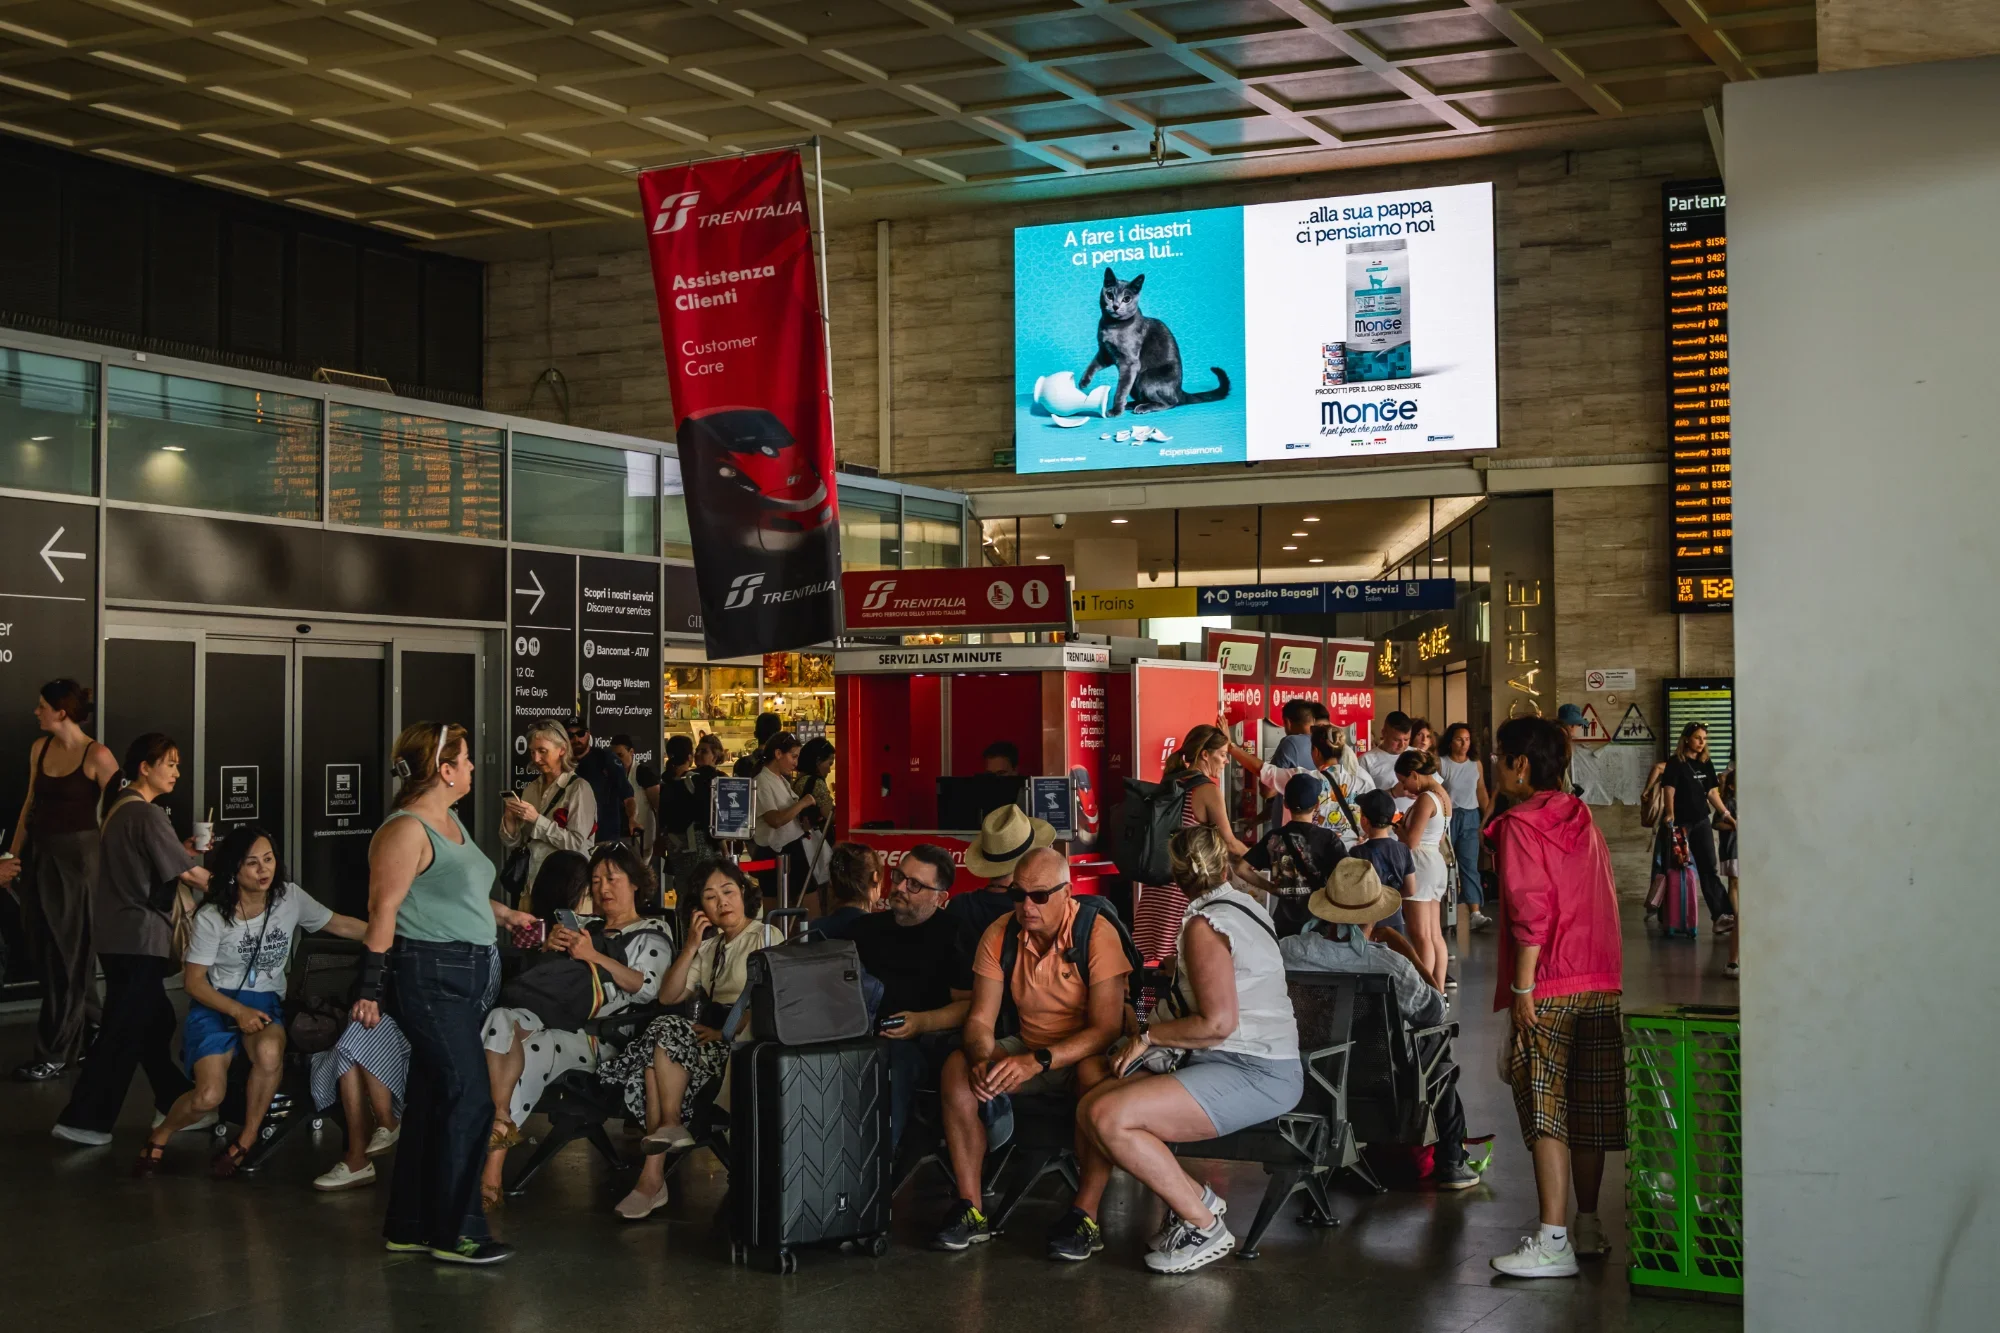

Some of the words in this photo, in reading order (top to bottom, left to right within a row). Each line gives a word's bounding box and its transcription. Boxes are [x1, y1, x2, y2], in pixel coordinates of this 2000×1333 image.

[1669, 195, 1727, 211] Partenz
[698, 201, 803, 229] TRENITALIA
[1299, 207, 1338, 225] ...alla
[1343, 207, 1373, 220] sua
[1378, 201, 1432, 222] pappa
[1064, 231, 1078, 247] A
[1081, 228, 1115, 246] fare
[1120, 228, 1125, 242] i
[1128, 219, 1192, 242] disastri
[1296, 227, 1311, 244] ci
[1316, 222, 1400, 246] pensiamo
[1407, 216, 1435, 234] noi
[1072, 249, 1088, 266] ci
[1092, 246, 1144, 268] pensa
[1149, 242, 1184, 259] lui...
[1707, 253, 1725, 263] 9427
[672, 265, 776, 291] Assistenza
[675, 288, 738, 311] Clienti
[682, 336, 758, 356] Customer
[685, 360, 724, 377] Care
[1349, 386, 1360, 394] PER
[1368, 385, 1385, 393] LORO
[1387, 383, 1422, 391] BENESSERE
[1326, 426, 1338, 436] pet
[1339, 425, 1356, 436] food
[1358, 425, 1370, 433] che
[1371, 424, 1392, 434] parla
[1395, 423, 1418, 431] chiaro
[1160, 446, 1223, 457] #cipensiamonoi
[1678, 577, 1693, 585] Lun
[584, 588, 606, 600] Scopri
[612, 590, 631, 600] nostri
[633, 592, 654, 602] servizi
[762, 580, 836, 605] TRENITALIA
[1235, 589, 1278, 600] Deposito
[1281, 587, 1319, 598] Bagagli
[1365, 585, 1399, 594] Servizi
[1681, 586, 1691, 594] 25
[893, 598, 967, 608] TRENITALIA
[1091, 596, 1134, 611] Trains
[1679, 594, 1693, 602] Mag
[586, 602, 614, 614] Discover
[616, 606, 625, 615] our
[627, 606, 651, 616] services
[597, 646, 630, 656] Bancomat
[635, 648, 649, 657] ATM
[878, 654, 918, 665] SERVIZI
[922, 653, 950, 664] LAST
[952, 652, 1002, 663] MINUTE
[1067, 653, 1095, 663] TRENITALIA
[1096, 654, 1107, 663] DESK
[516, 668, 524, 677] 12
[525, 668, 535, 678] Oz
[1229, 663, 1252, 672] TRENITALIA
[1289, 667, 1311, 675] TRENITALIA
[1345, 670, 1364, 678] TRENITALIA
[597, 677, 622, 689] Change
[624, 678, 650, 689] Western
[516, 687, 530, 696] Five
[532, 687, 548, 698] Guys
[596, 691, 616, 701] Union
[1080, 685, 1087, 696] Le
[1071, 697, 1076, 709] di
[1338, 693, 1358, 706] Biglietti
[516, 706, 571, 718] Rossopomodoro
[596, 706, 623, 716] Currency
[624, 706, 653, 716] Exchange
[1080, 712, 1091, 722] treni
[1081, 740, 1084, 748] e
[516, 766, 524, 775] La
[264, 941, 288, 951] DRAGON
